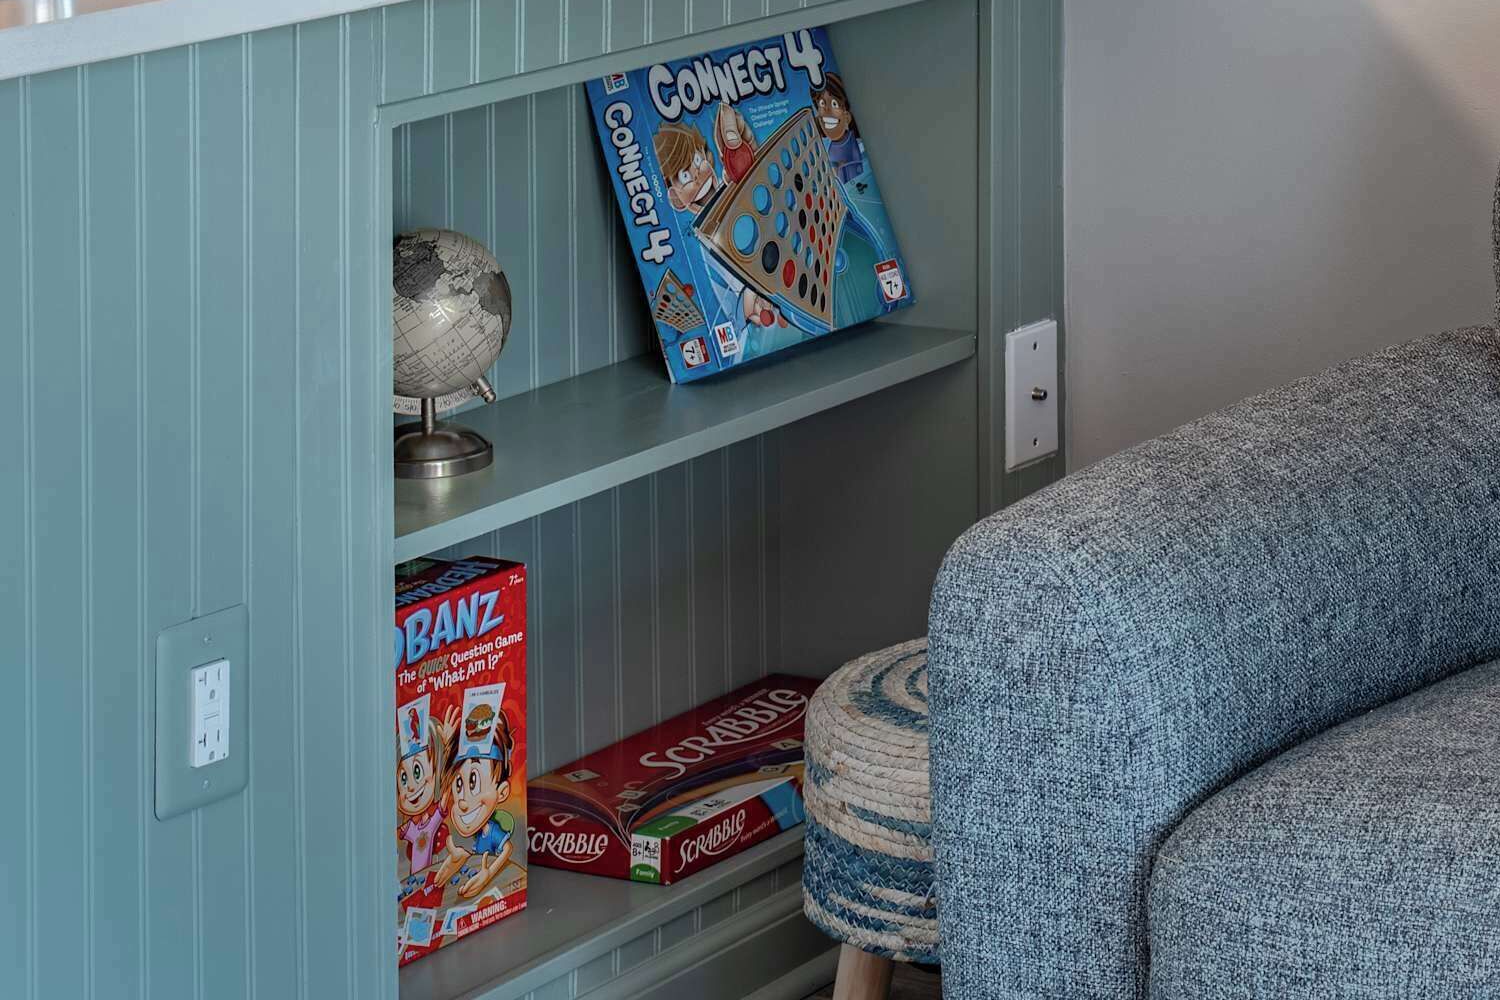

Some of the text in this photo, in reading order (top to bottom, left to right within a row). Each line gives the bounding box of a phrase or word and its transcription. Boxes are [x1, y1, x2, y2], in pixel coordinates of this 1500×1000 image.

[648, 28, 824, 120] CONNECT 4
[604, 101, 660, 227] CONNECT
[641, 229, 674, 264] 4
[886, 280, 899, 295] 7+
[717, 326, 734, 345] MB
[398, 631, 523, 687] The QUICK Question Game
[417, 680, 427, 693] of
[429, 667, 466, 692] "What
[466, 658, 485, 680] Am
[639, 688, 806, 781] SCRABBLE
[674, 808, 747, 873] SCRABBLE
[470, 900, 507, 924] WARNING:
